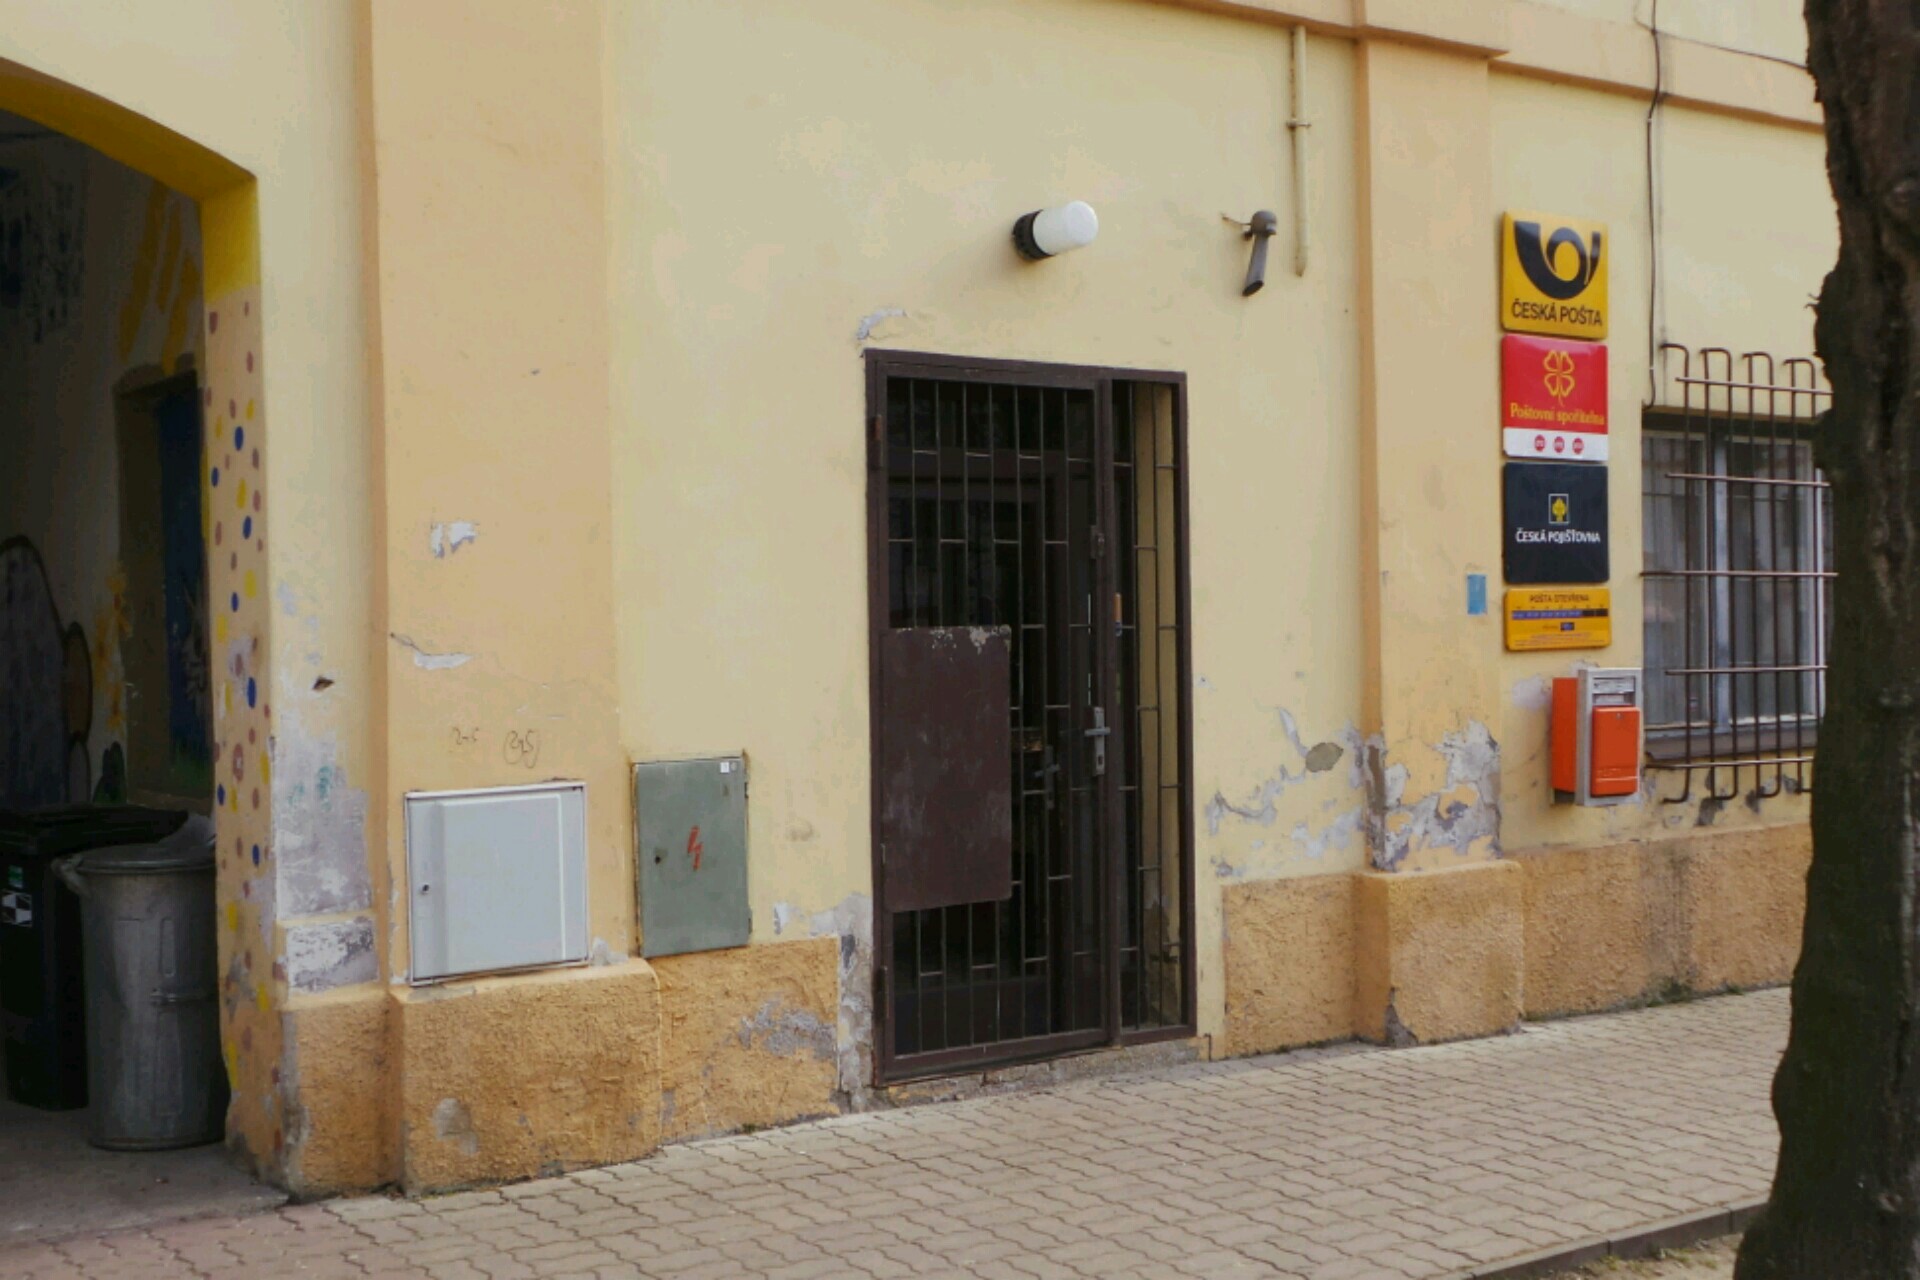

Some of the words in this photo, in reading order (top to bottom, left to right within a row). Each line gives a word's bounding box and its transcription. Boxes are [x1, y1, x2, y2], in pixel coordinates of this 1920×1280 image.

[1512, 299, 1557, 322] ČESKÁ
[1560, 304, 1602, 326] POŠTA
[1510, 402, 1555, 421] Poštovní
[1515, 528, 1546, 542] ČESKÁ
